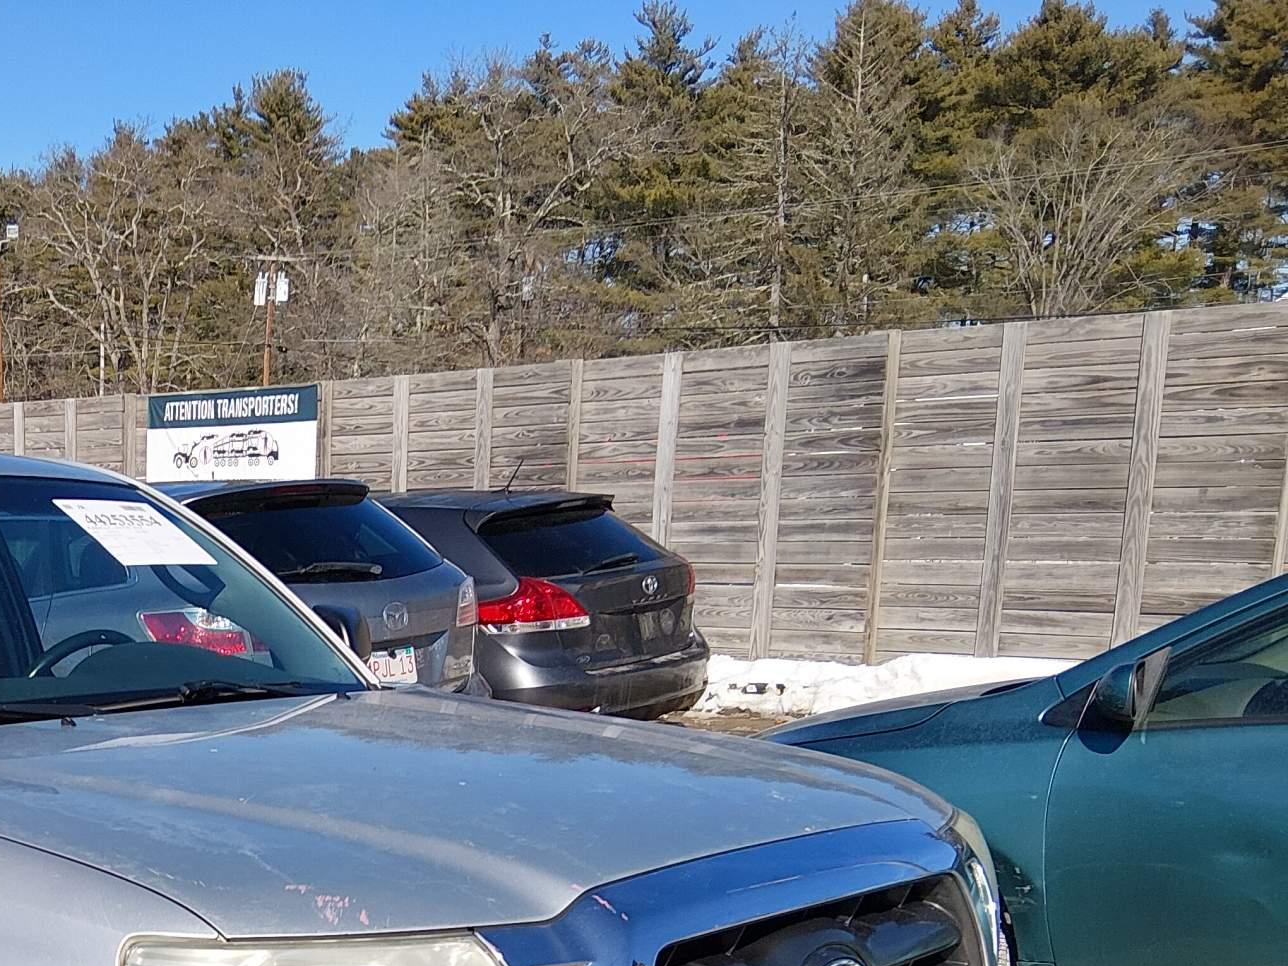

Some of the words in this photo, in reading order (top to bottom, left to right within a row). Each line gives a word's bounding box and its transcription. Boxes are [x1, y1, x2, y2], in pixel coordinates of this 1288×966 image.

[164, 399, 214, 422] ATTENTION
[217, 393, 299, 417] TRANSPORTERS!
[85, 513, 162, 526] 44253554
